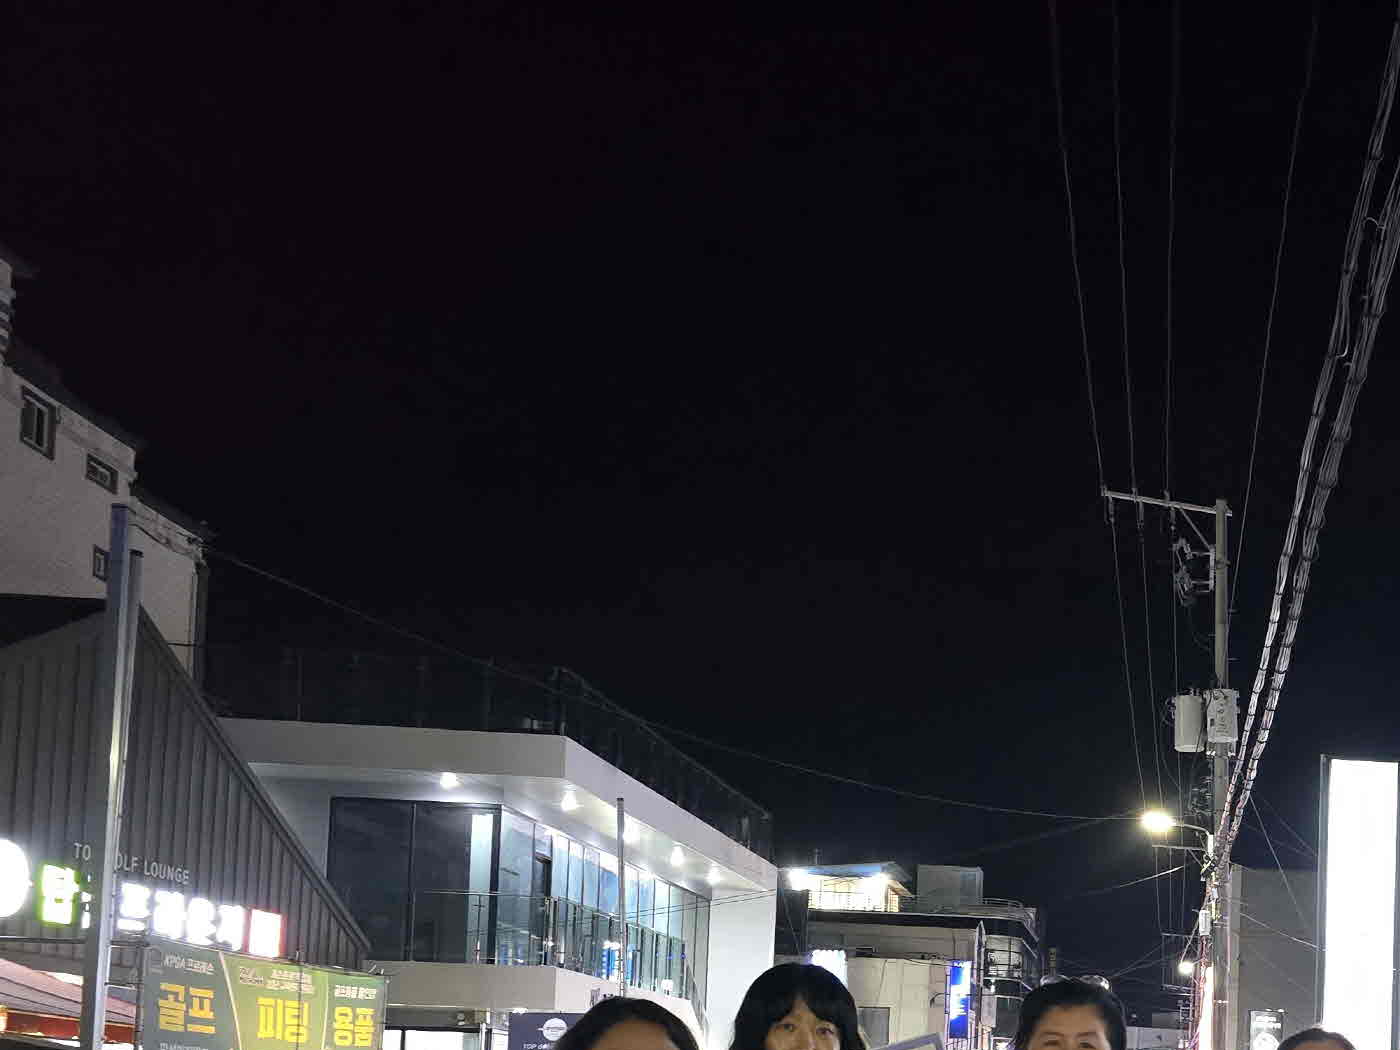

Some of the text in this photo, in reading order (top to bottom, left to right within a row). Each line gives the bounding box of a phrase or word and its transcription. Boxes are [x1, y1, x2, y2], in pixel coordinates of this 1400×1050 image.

[115, 853, 138, 872] OLF
[143, 860, 191, 885] LOUNGE
[158, 982, 216, 1035] 골프
[256, 996, 310, 1043] 피팅
[334, 1006, 376, 1048] 용품
